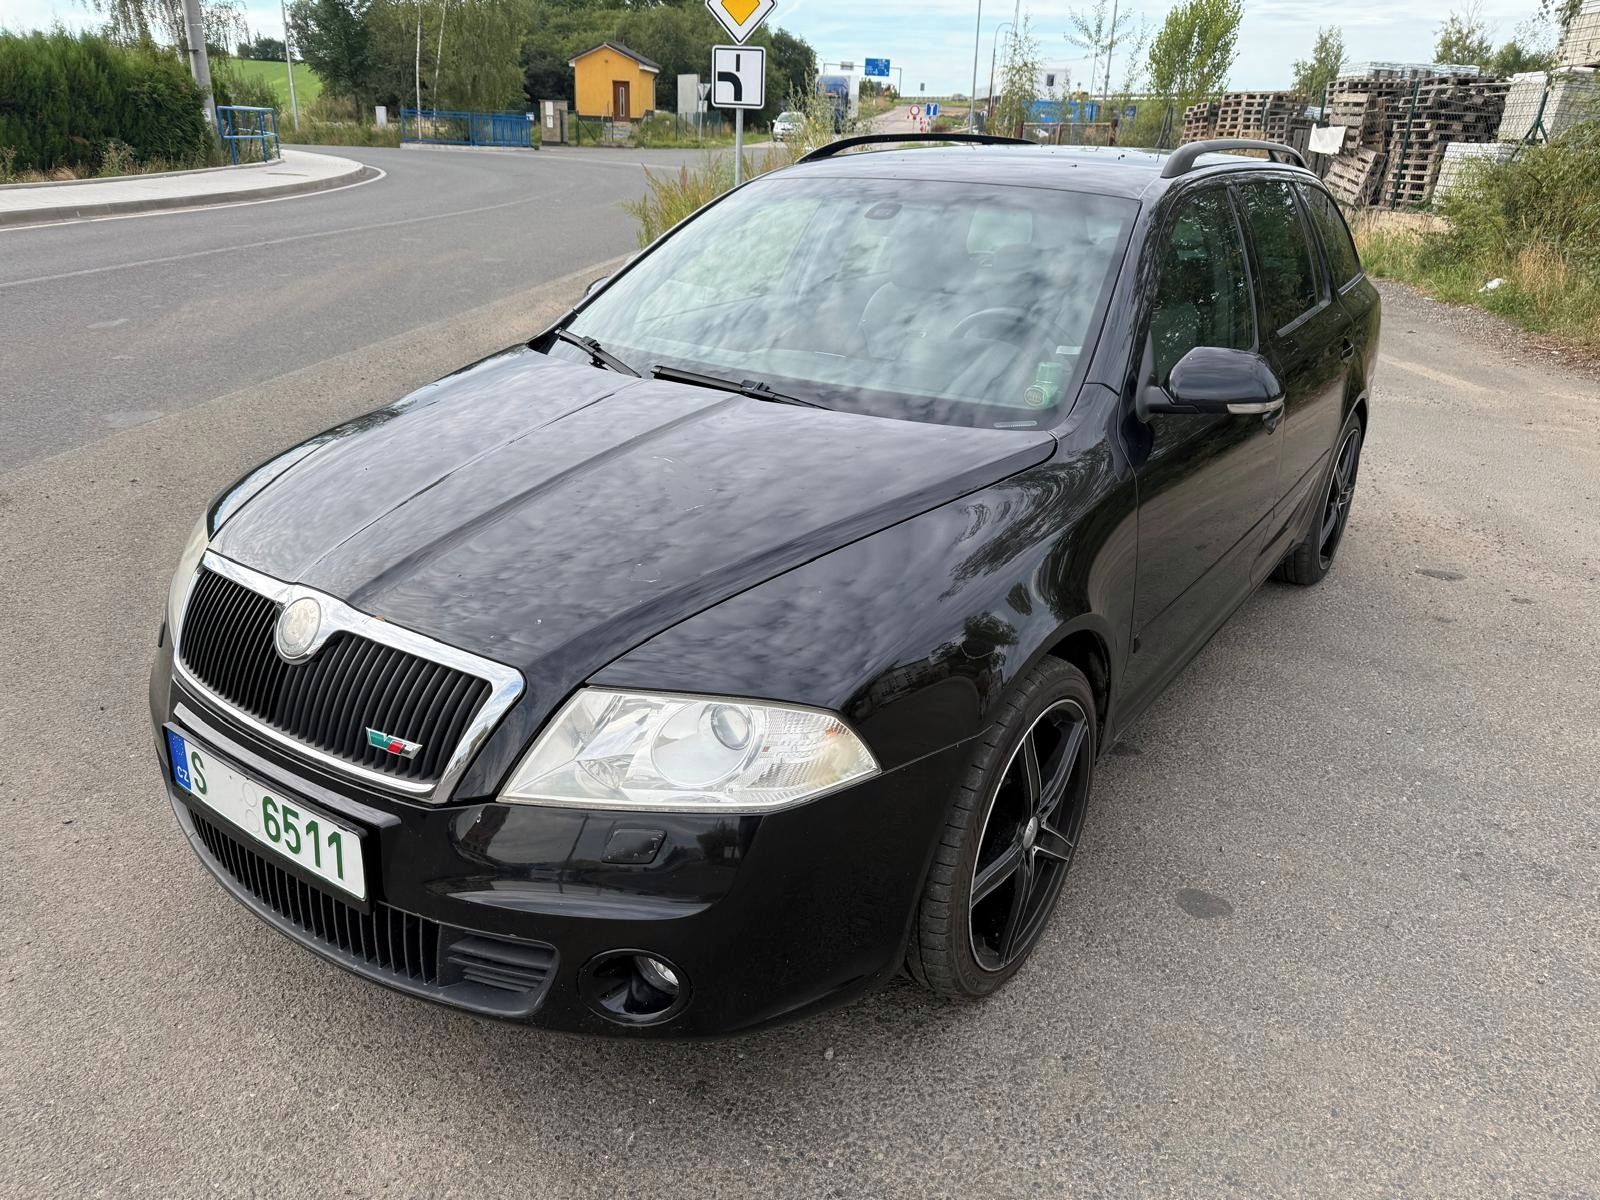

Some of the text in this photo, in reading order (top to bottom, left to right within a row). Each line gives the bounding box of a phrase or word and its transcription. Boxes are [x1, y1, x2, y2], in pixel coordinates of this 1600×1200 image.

[177, 765, 190, 783] CZ
[191, 751, 344, 880] S 6511
